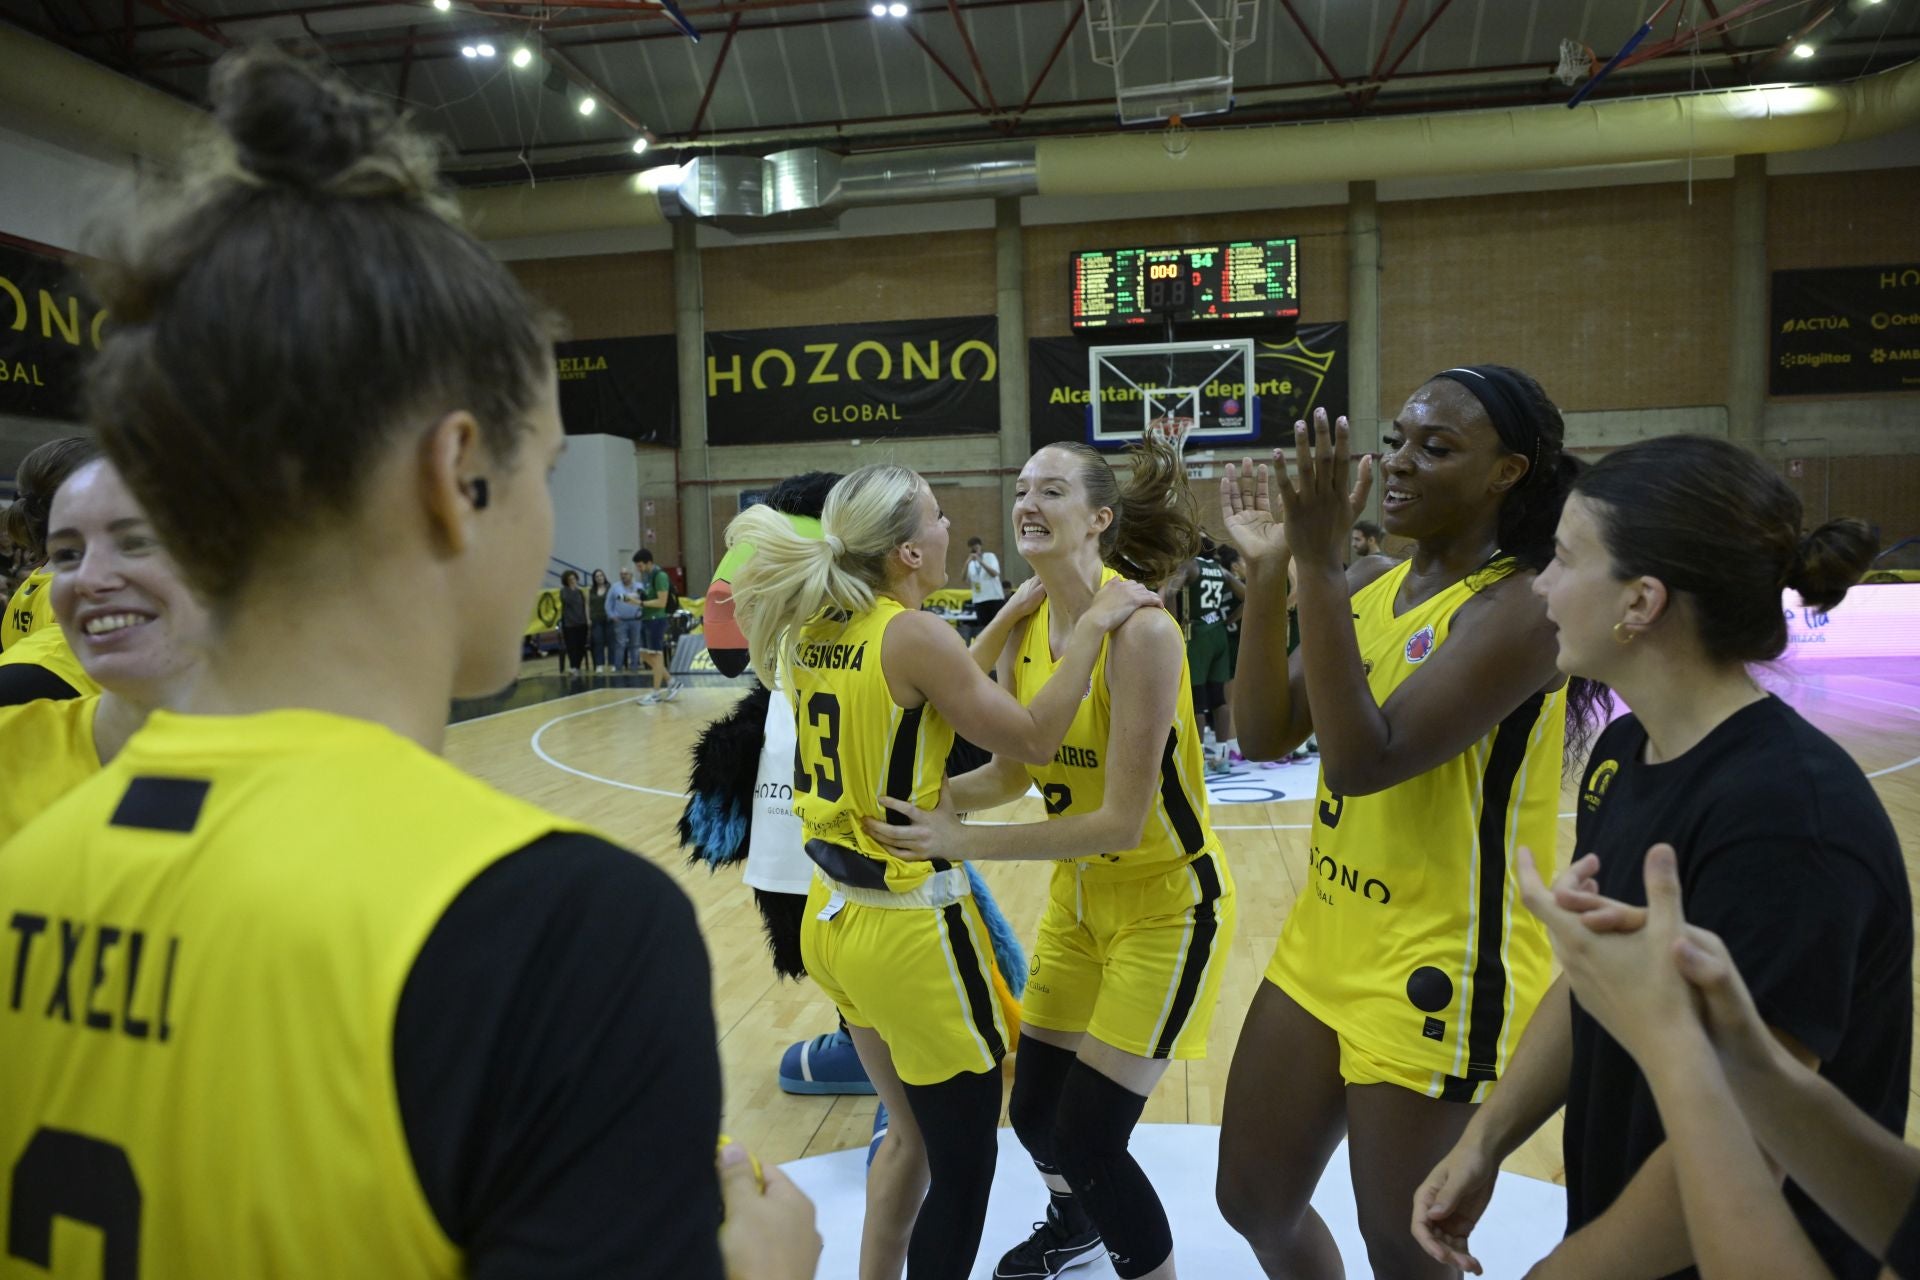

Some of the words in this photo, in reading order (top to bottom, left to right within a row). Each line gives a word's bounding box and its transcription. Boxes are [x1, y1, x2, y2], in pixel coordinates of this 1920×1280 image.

[707, 340, 998, 397] HOZONO
[813, 403, 902, 424] GLOBAL
[1200, 579, 1224, 609] 23
